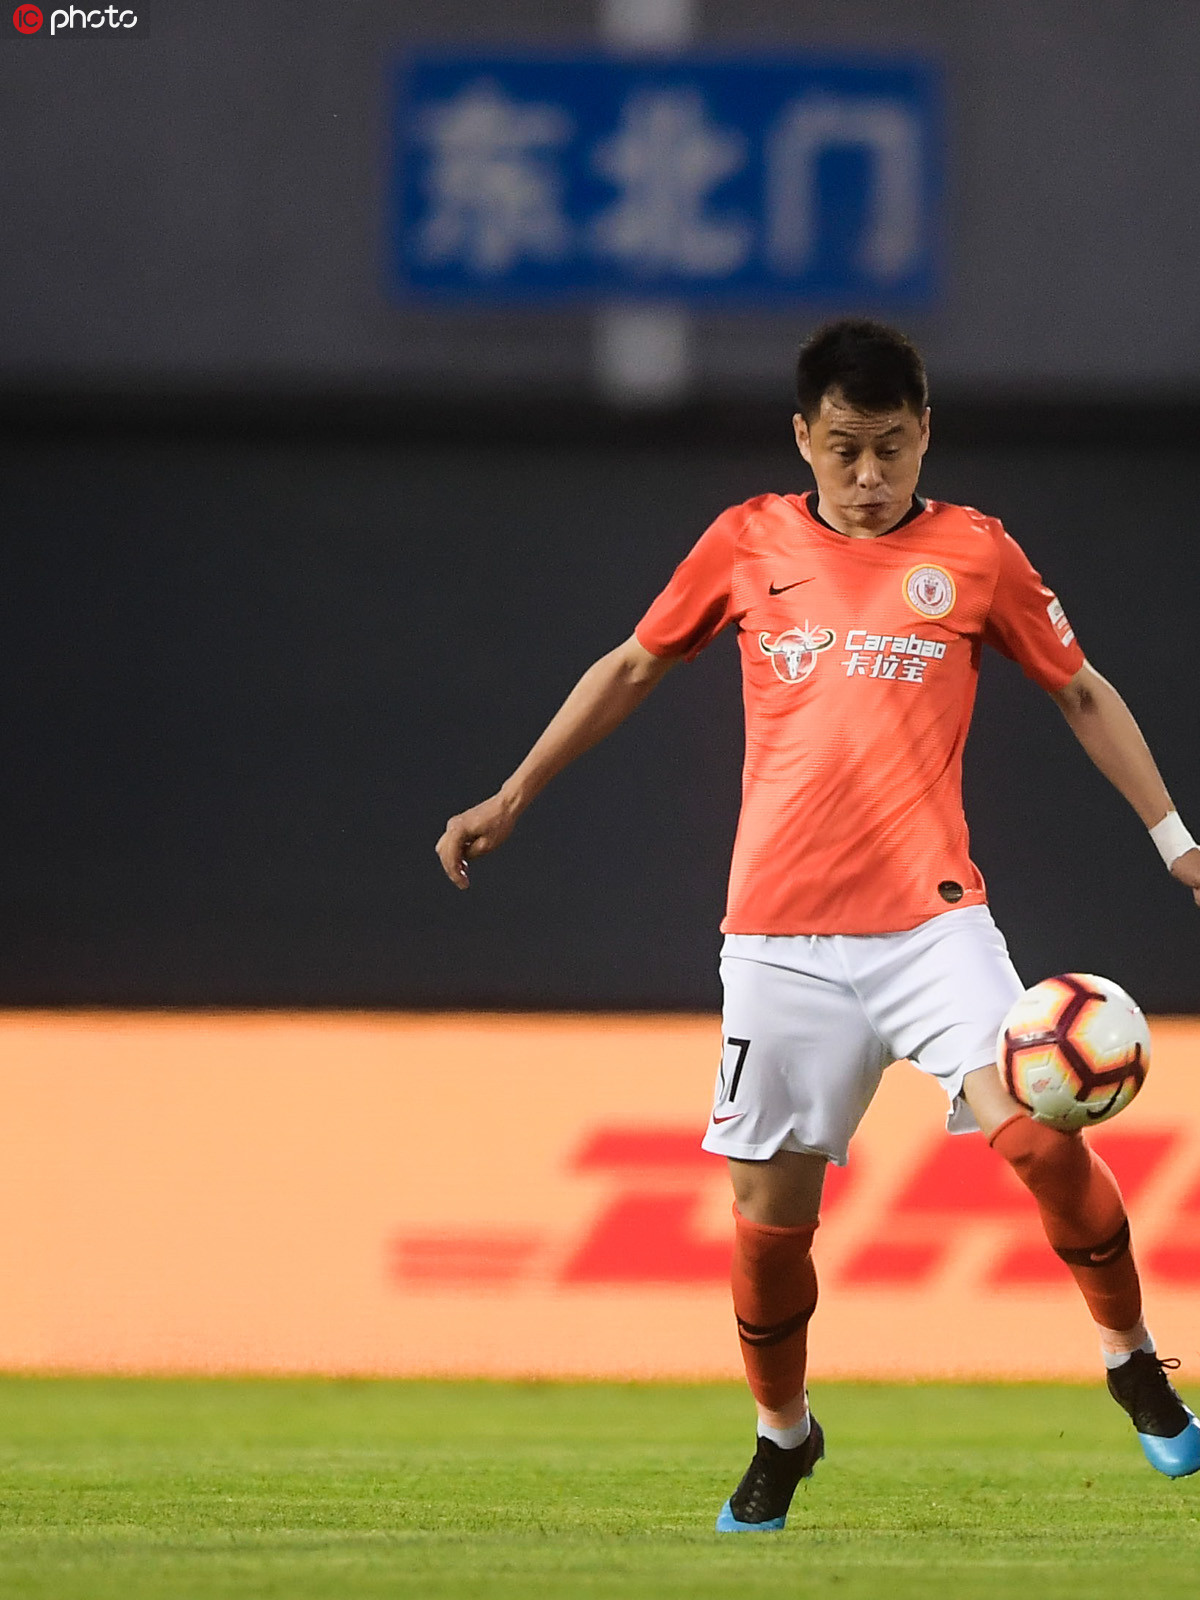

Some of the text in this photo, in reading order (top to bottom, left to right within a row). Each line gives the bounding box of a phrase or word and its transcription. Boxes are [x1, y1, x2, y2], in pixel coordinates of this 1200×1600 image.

[410, 84, 922, 276] 东北门
[840, 652, 928, 683] 卡拉宝
[844, 630, 947, 660] Carabao
[720, 1036, 751, 1103] 7
